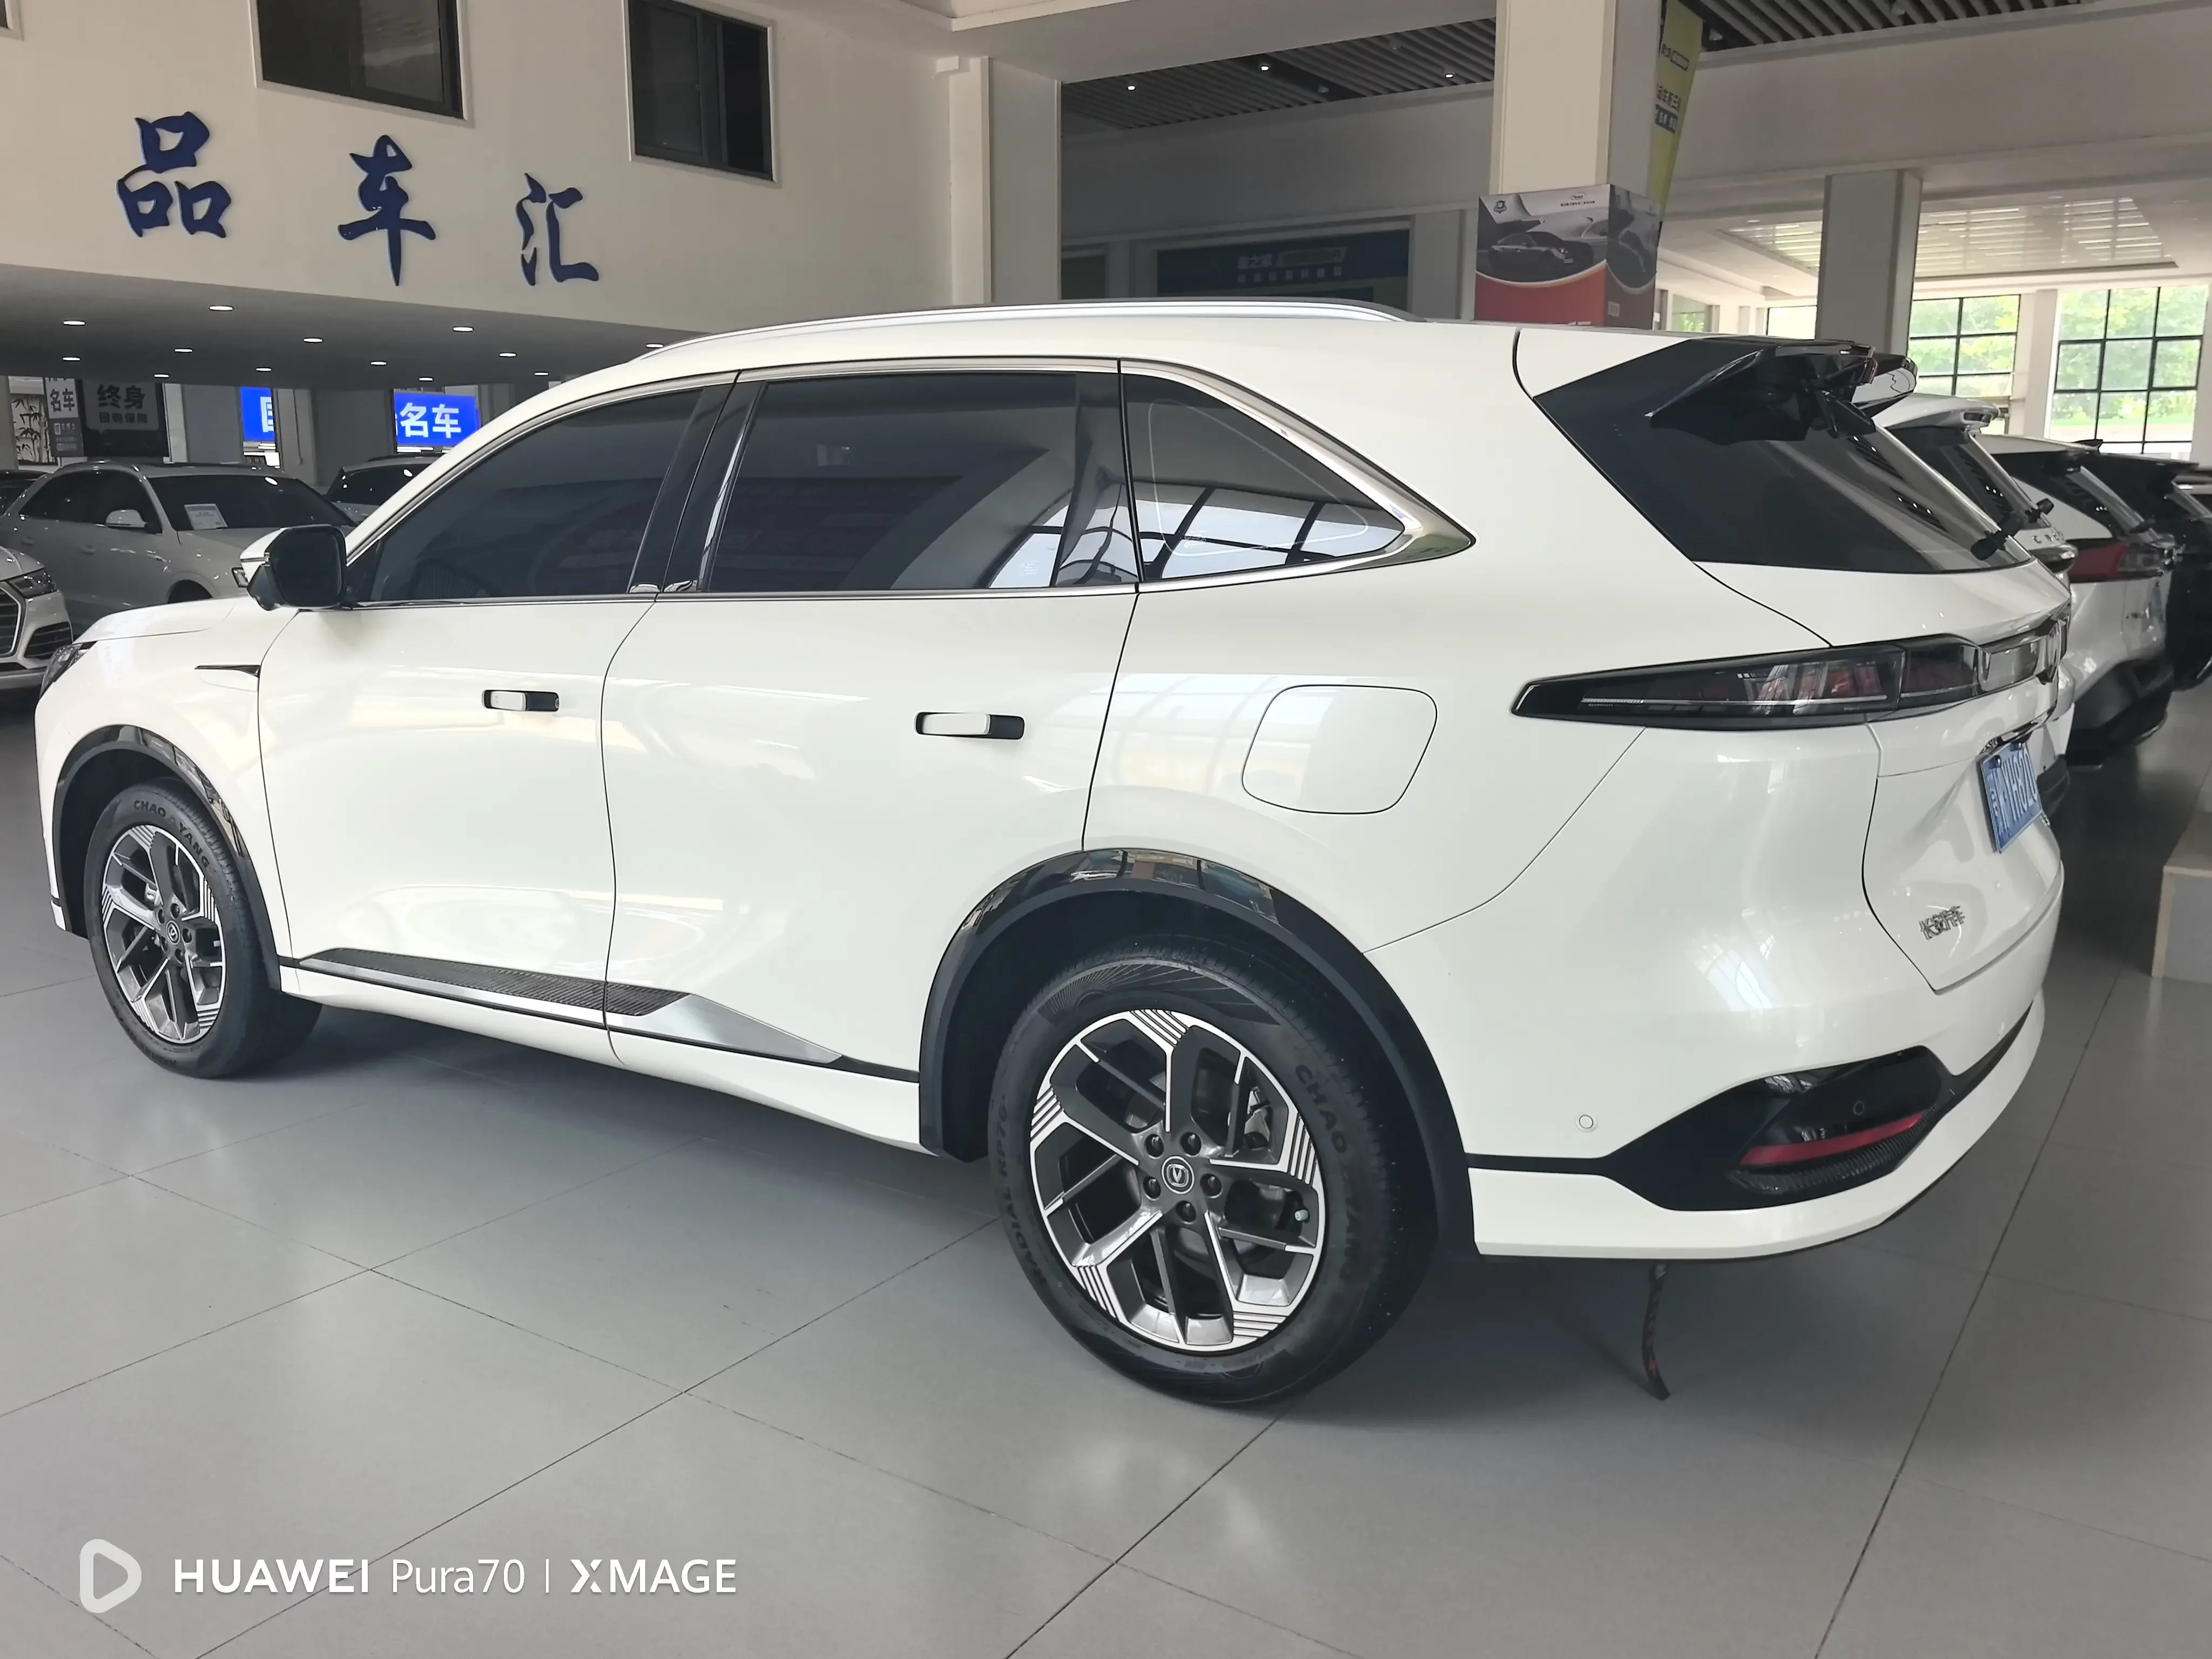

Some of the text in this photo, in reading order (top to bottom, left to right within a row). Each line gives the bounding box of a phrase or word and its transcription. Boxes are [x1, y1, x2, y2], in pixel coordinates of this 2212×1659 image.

[116, 111, 600, 287] 品车汇
[50, 388, 76, 413] 名车
[96, 384, 145, 410] 终身
[396, 402, 462, 439] 名车
[133, 799, 210, 868] CHAO YANG
[1294, 1064, 1347, 1154] CHAO
